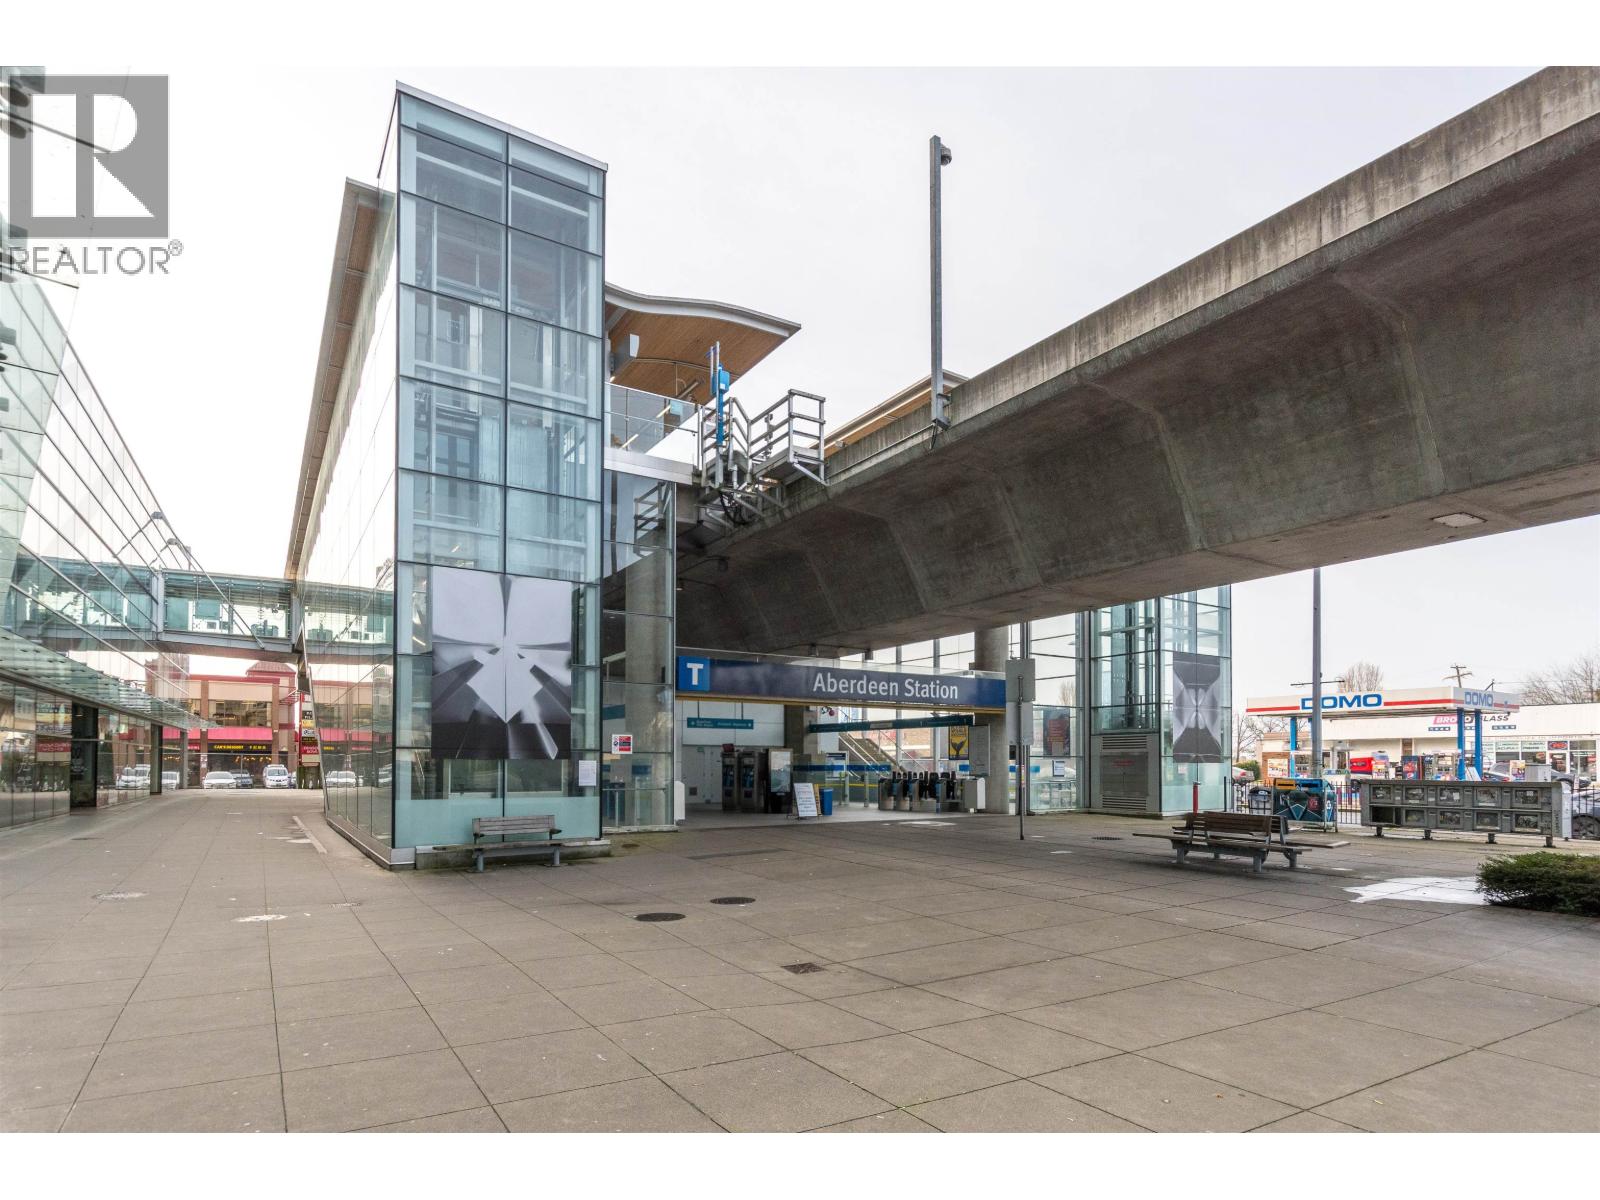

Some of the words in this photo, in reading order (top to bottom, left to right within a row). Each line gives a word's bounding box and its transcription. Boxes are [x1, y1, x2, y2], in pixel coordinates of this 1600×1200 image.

[686, 662, 704, 686] T
[812, 672, 899, 696] Aberdeen
[904, 679, 958, 699] Station
[1301, 693, 1383, 711] DOMO
[1464, 692, 1493, 707] DOMO
